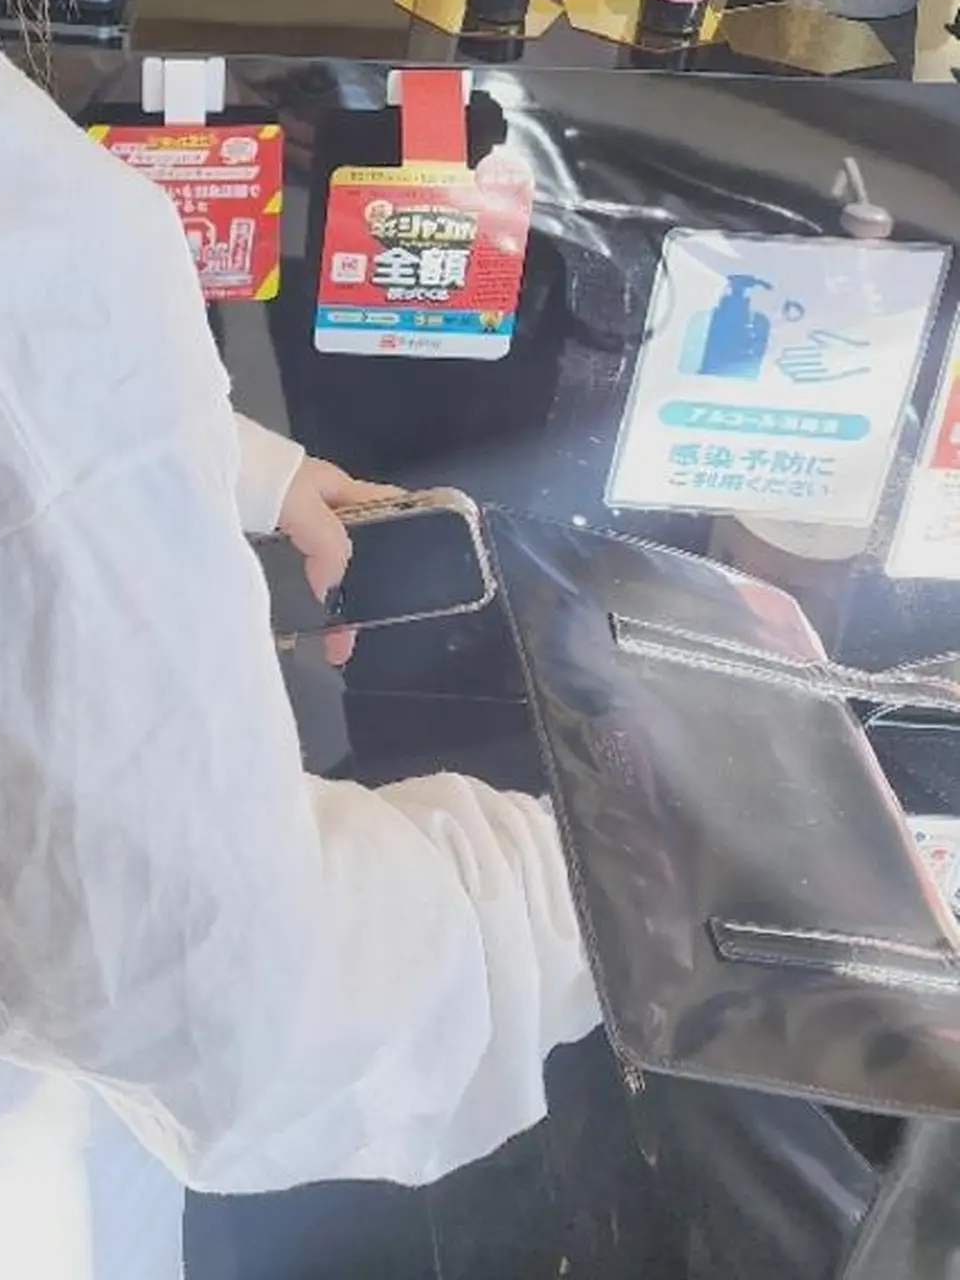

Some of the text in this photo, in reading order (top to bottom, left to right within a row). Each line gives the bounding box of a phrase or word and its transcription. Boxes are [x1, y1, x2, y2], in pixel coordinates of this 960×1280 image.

[371, 247, 471, 288] 全額
[668, 443, 836, 476] 感染予防に
[667, 470, 834, 498] ご利用ください
